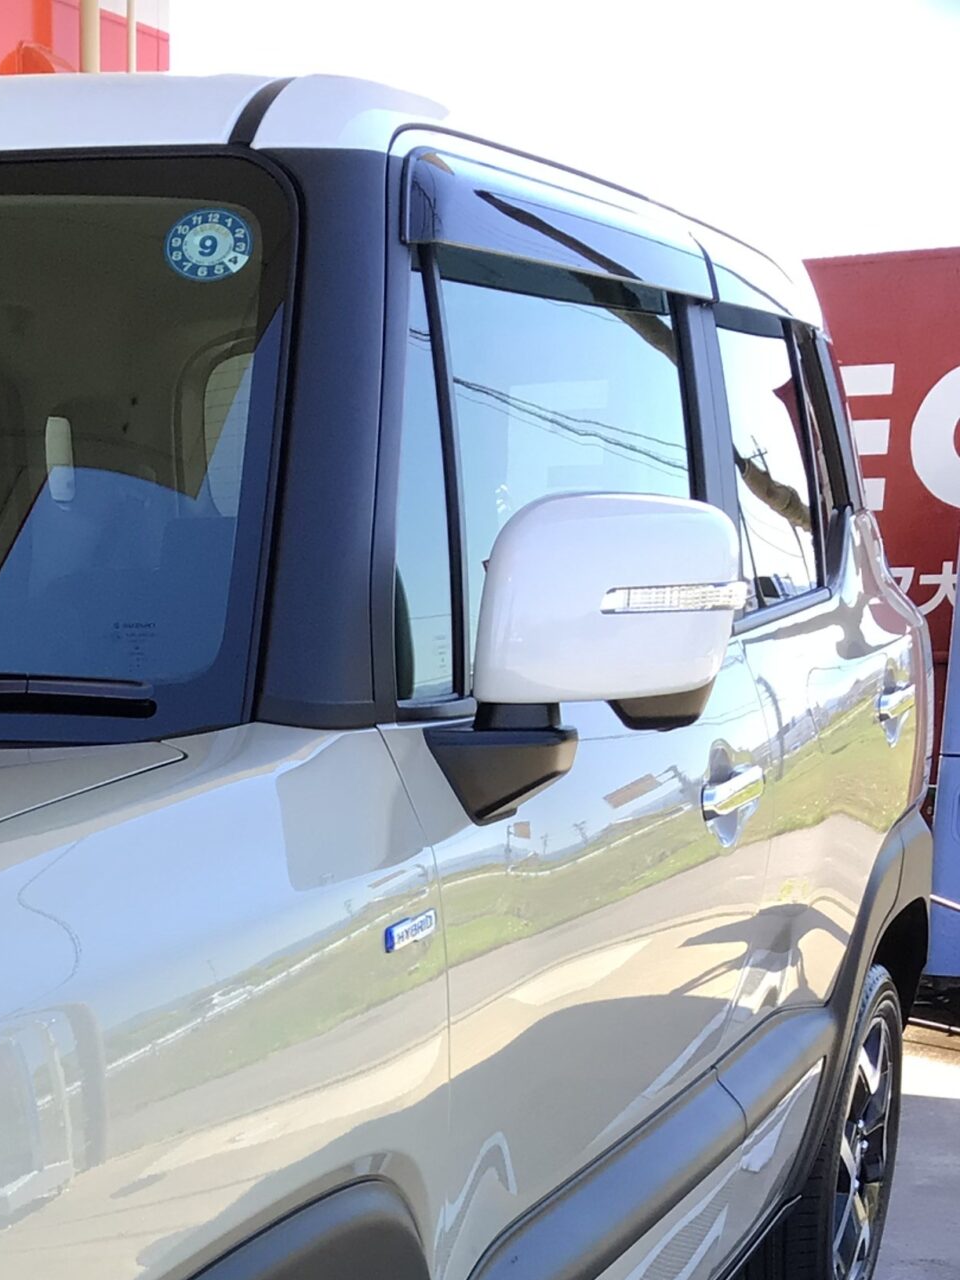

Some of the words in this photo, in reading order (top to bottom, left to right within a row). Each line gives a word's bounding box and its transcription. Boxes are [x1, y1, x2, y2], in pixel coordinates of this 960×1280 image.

[192, 215, 202, 225] 11
[207, 213, 220, 223] 12
[225, 217, 233, 227] 1
[176, 225, 189, 235] 10
[235, 228, 245, 238] 2
[171, 237, 181, 247] 9
[198, 235, 218, 257] 9
[235, 242, 246, 252] 3
[172, 250, 182, 261] 8
[228, 256, 238, 265] 4
[182, 262, 192, 271] 7
[197, 266, 207, 277] 6
[214, 264, 224, 274] 5
[397, 914, 433, 942] HYBRID
